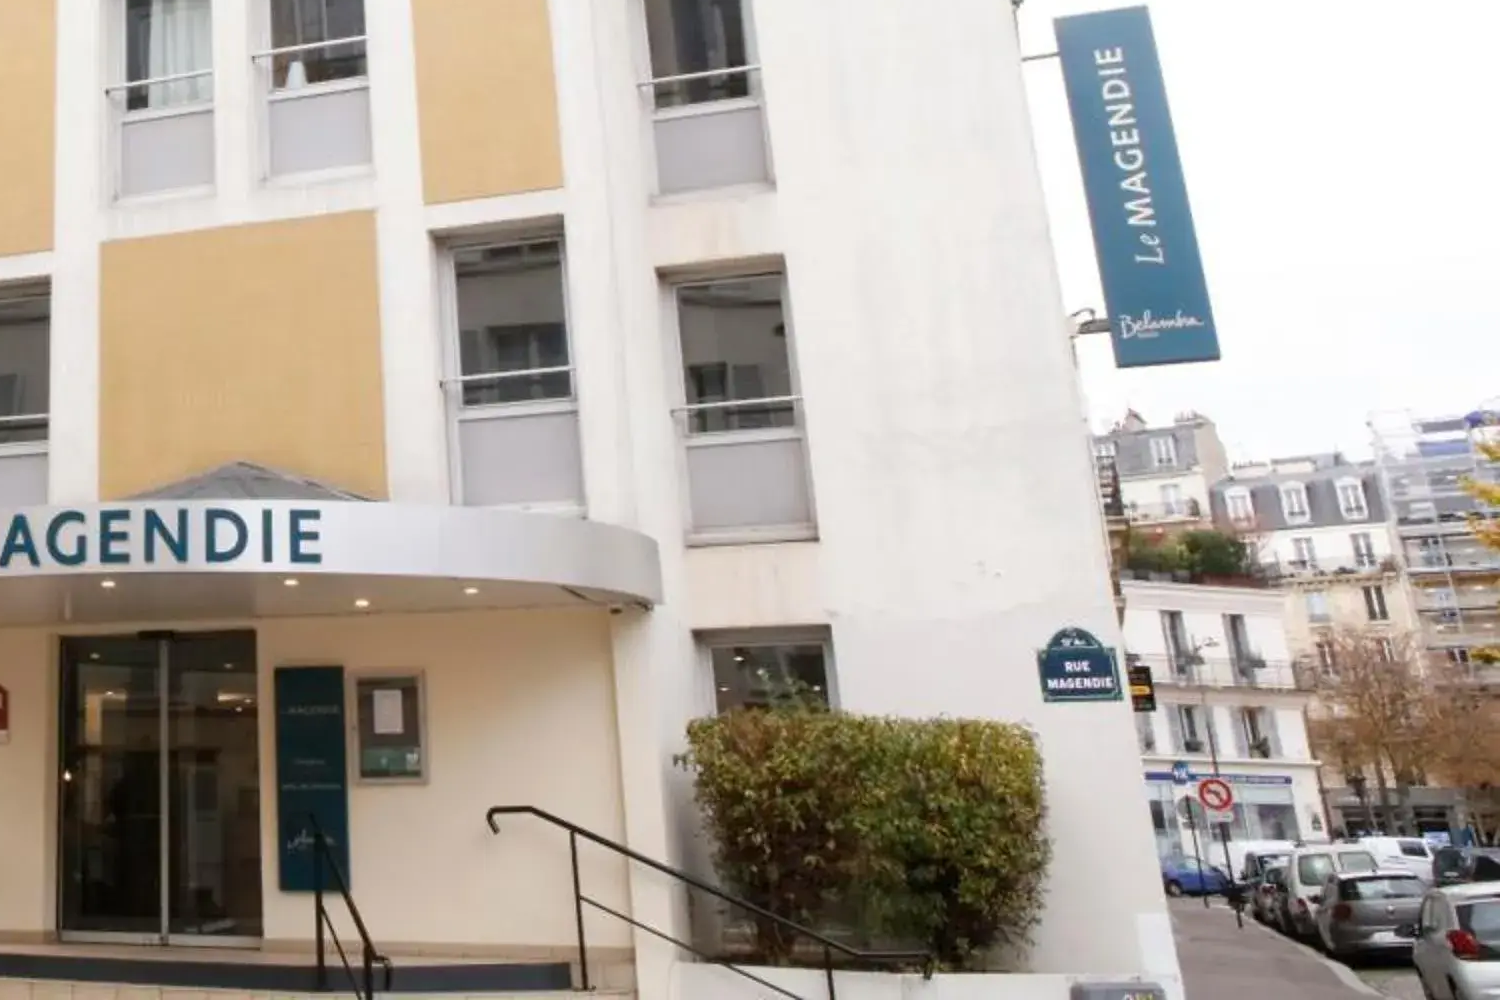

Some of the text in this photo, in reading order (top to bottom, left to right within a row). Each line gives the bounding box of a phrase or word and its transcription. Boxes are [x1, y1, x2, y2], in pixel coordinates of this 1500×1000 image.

[1094, 46, 1165, 265] Le MAGENDIE
[1118, 308, 1205, 339] Belambra
[1064, 660, 1091, 673] RUE
[1046, 677, 1113, 690] MAGENDIE
